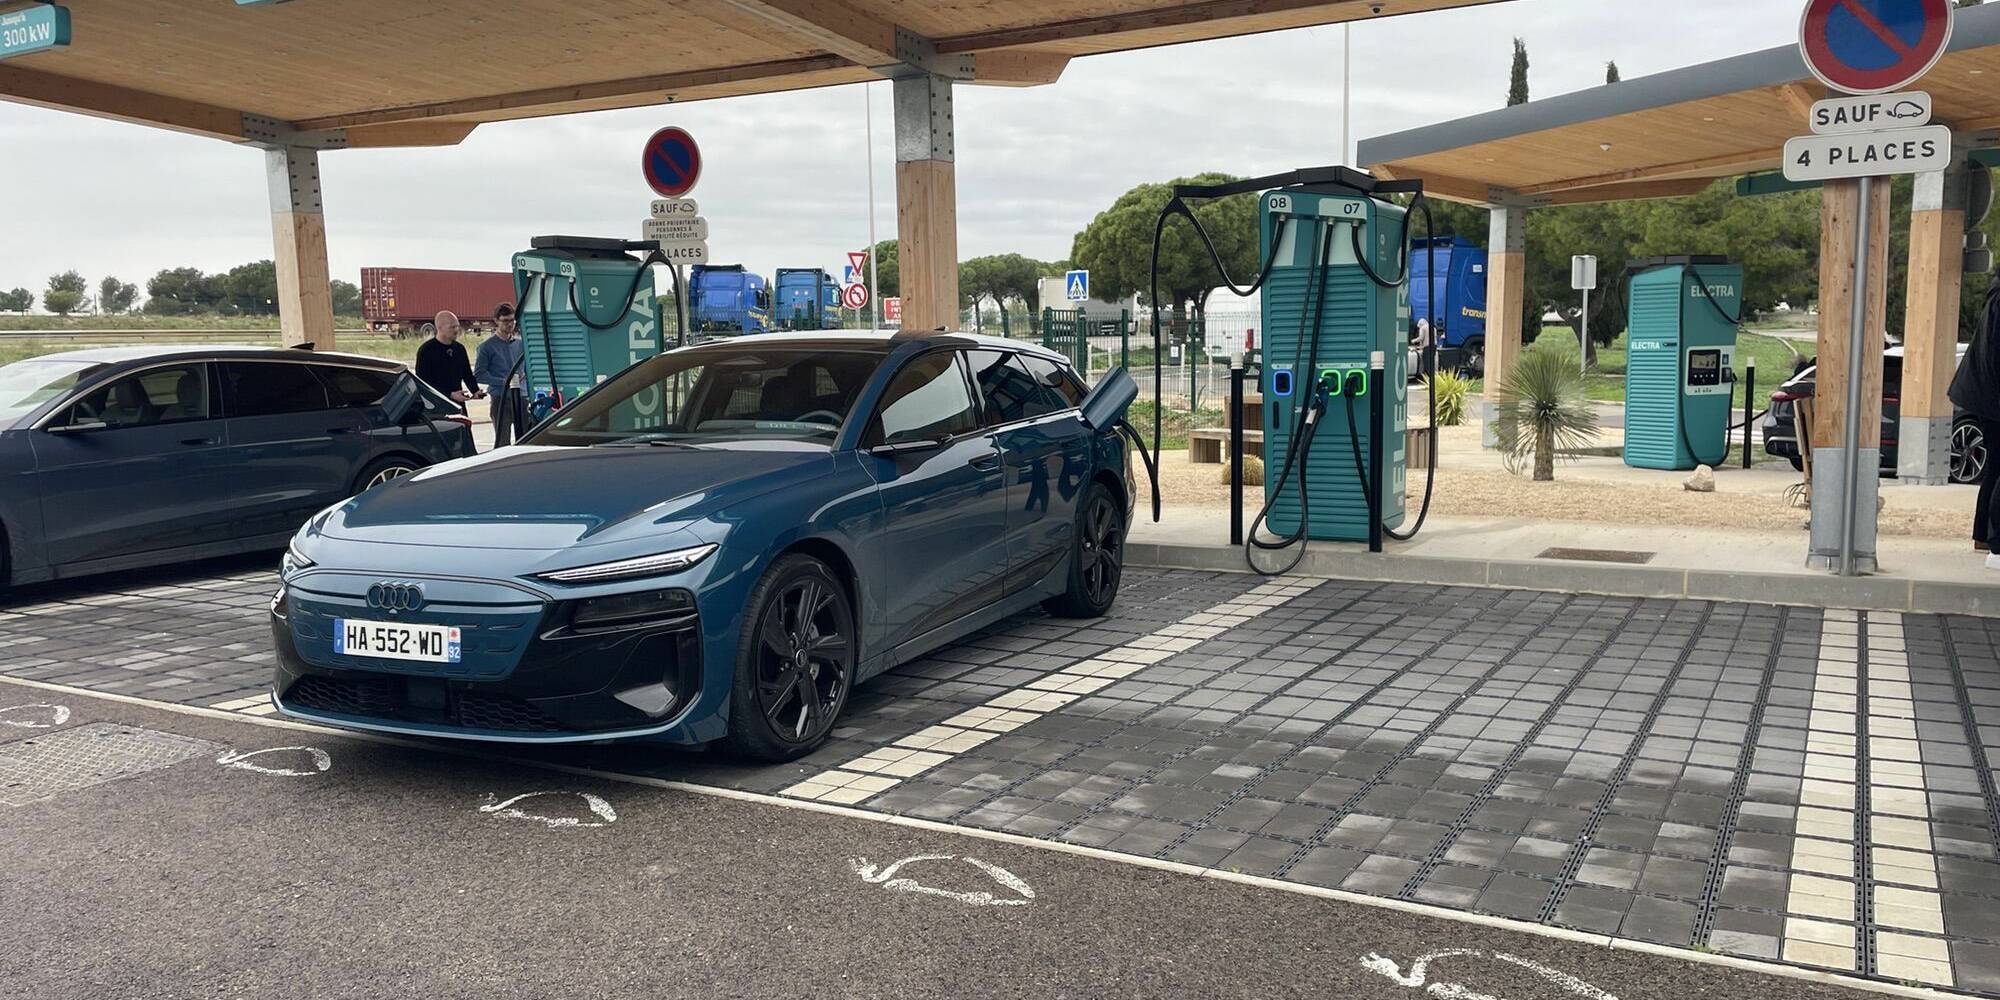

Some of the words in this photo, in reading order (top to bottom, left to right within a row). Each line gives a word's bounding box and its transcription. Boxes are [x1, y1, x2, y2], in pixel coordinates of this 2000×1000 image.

[4, 27, 27, 47] 300
[29, 21, 50, 42] kW
[1816, 103, 1882, 126] SAUF
[1796, 150, 1811, 167] 4
[1829, 140, 1936, 165] PLACES
[1269, 197, 1287, 208] 08
[653, 203, 678, 214] SAUF
[1343, 203, 1360, 214] 07
[517, 257, 527, 268] 10
[561, 264, 573, 273] 09
[1631, 341, 1661, 350] ELECTRA
